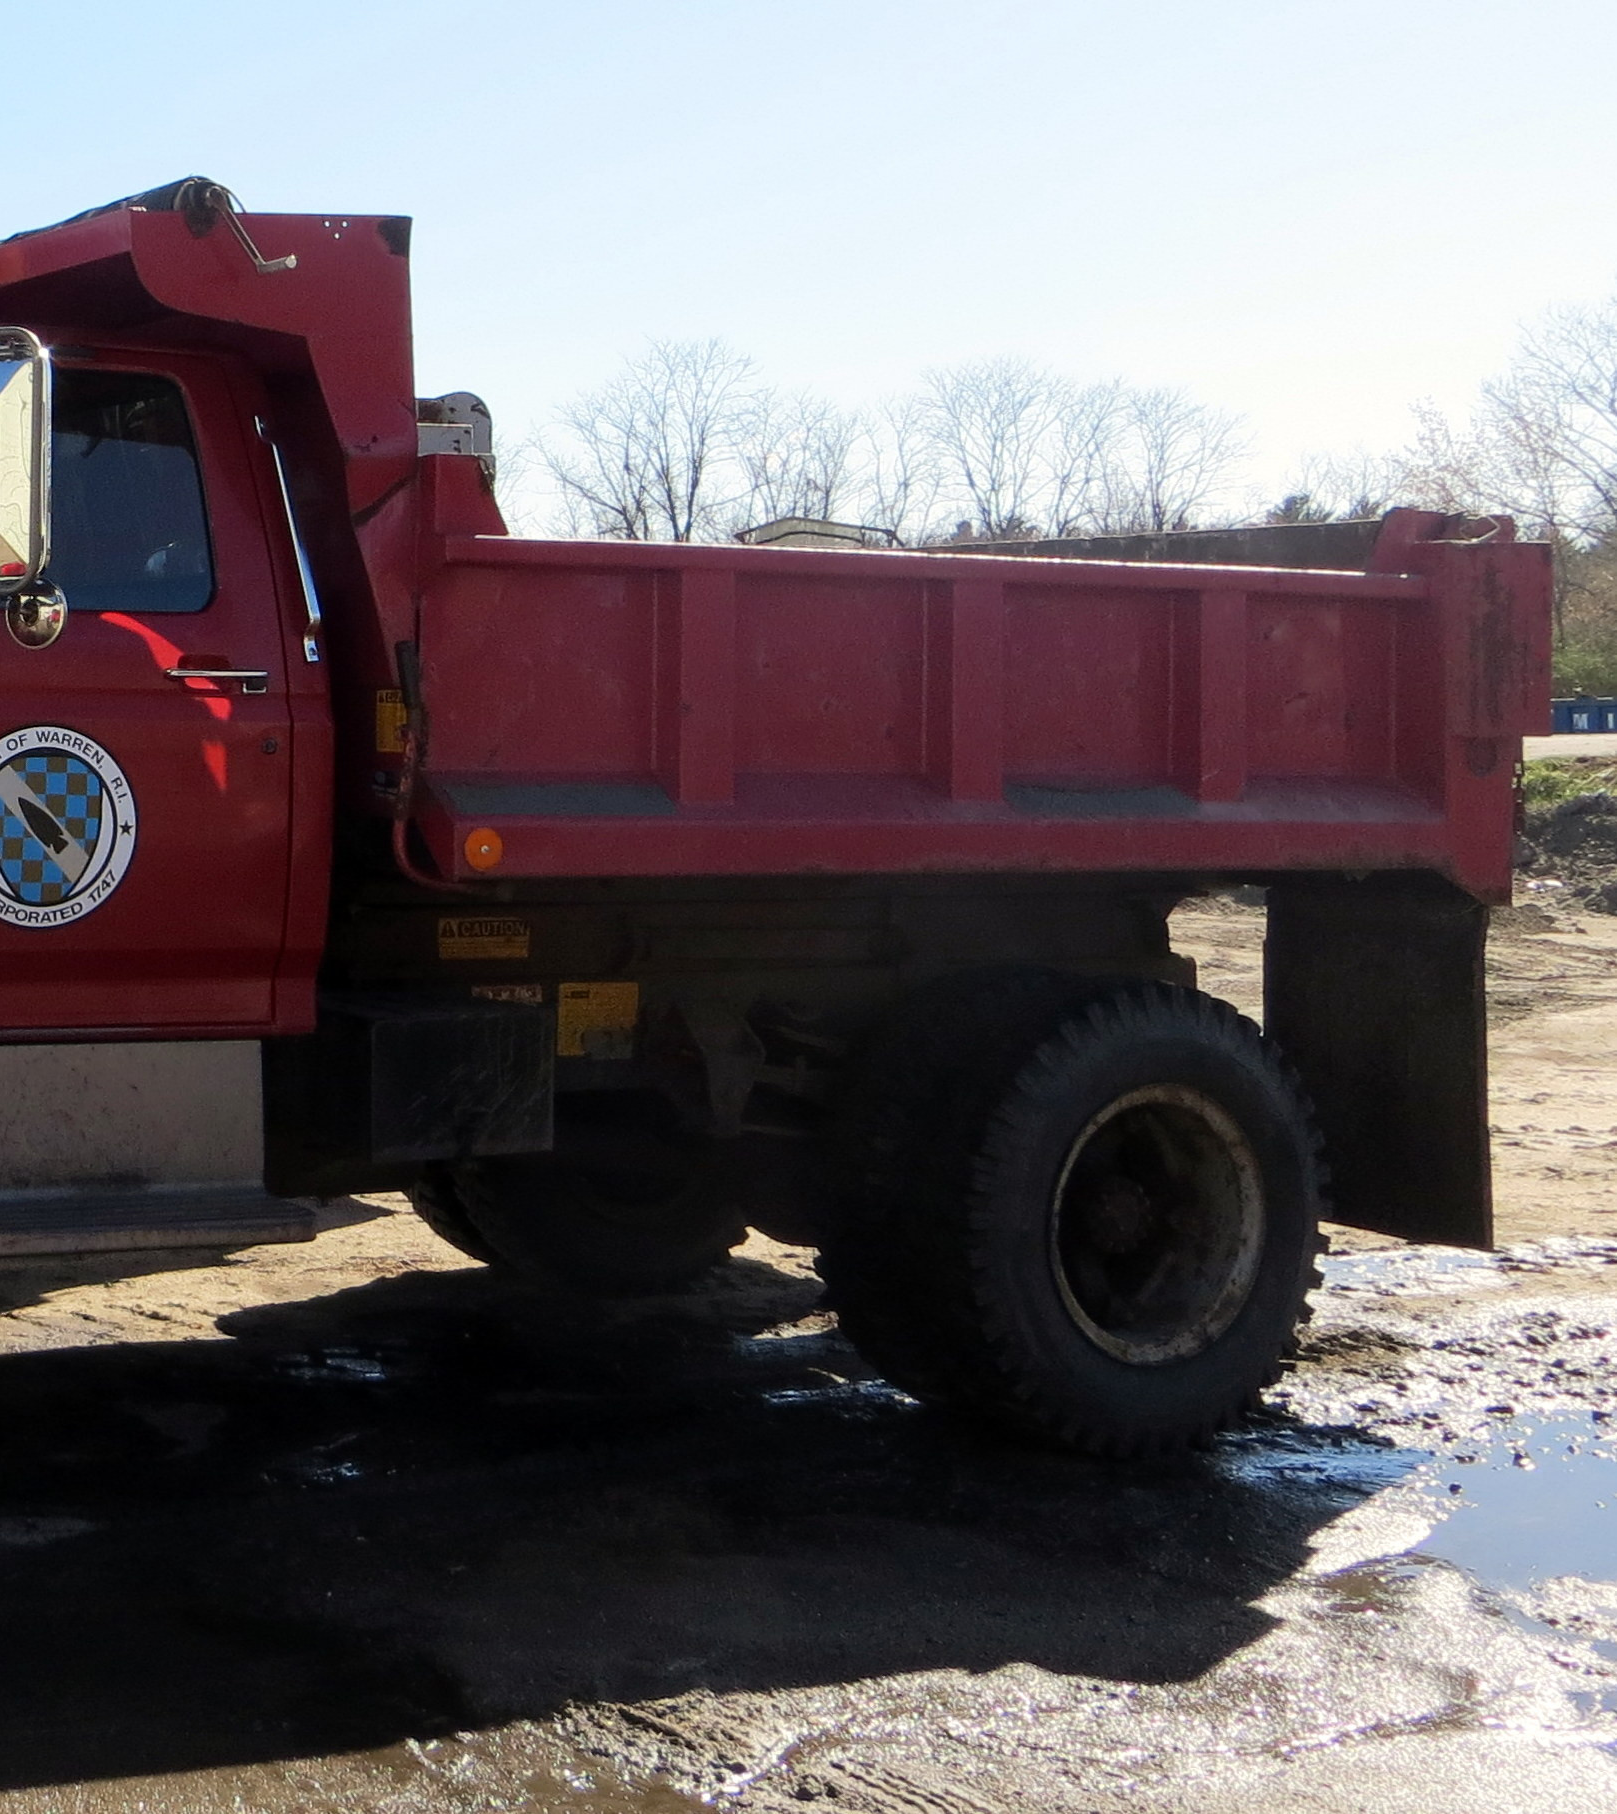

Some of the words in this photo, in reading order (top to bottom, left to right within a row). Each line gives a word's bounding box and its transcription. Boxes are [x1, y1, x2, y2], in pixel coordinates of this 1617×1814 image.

[6, 733, 28, 752] OF
[36, 730, 106, 769] WARREN,
[110, 776, 128, 804] R.I.
[87, 869, 117, 903] 1747
[461, 921, 527, 936] CAUTION
